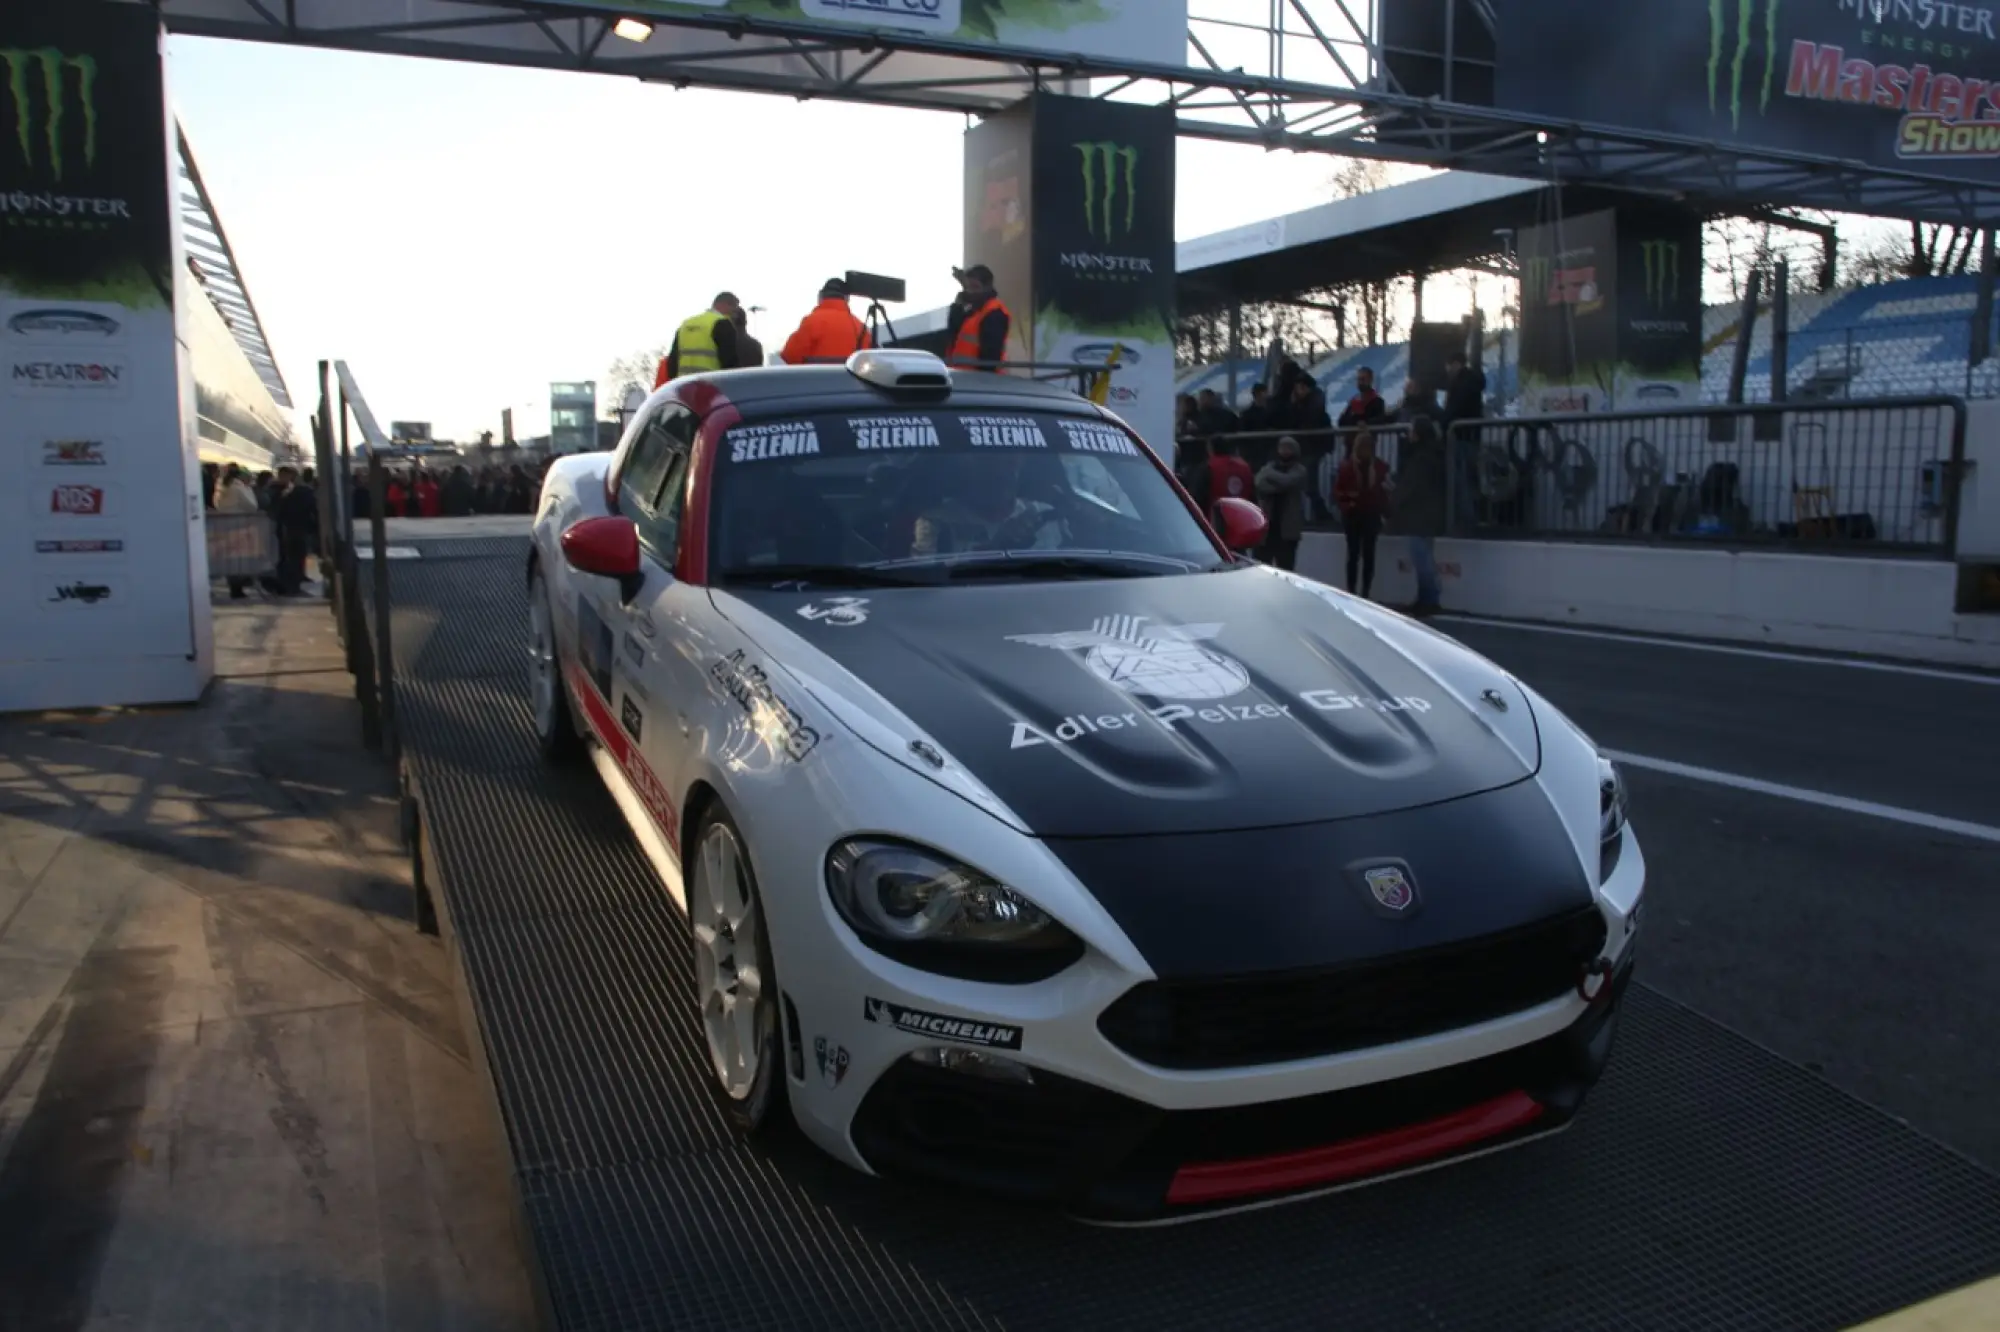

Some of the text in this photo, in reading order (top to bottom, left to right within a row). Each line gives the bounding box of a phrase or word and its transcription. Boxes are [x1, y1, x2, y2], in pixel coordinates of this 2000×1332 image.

[1861, 29, 1971, 59] ENERGY
[1900, 119, 2000, 153] Show
[1061, 251, 1153, 273] MONSTER
[726, 421, 815, 439] PETRONAS
[847, 416, 932, 427] PETRONAS
[958, 416, 1037, 426] PETRONAS
[731, 431, 820, 462] SELENIA
[856, 426, 940, 449] SELENIA
[970, 425, 1048, 447] SELENIA
[1068, 430, 1138, 456] SELENIA
[1010, 689, 1433, 748] Adler Pelzer Grup
[899, 1011, 1016, 1042] MICHELIN
